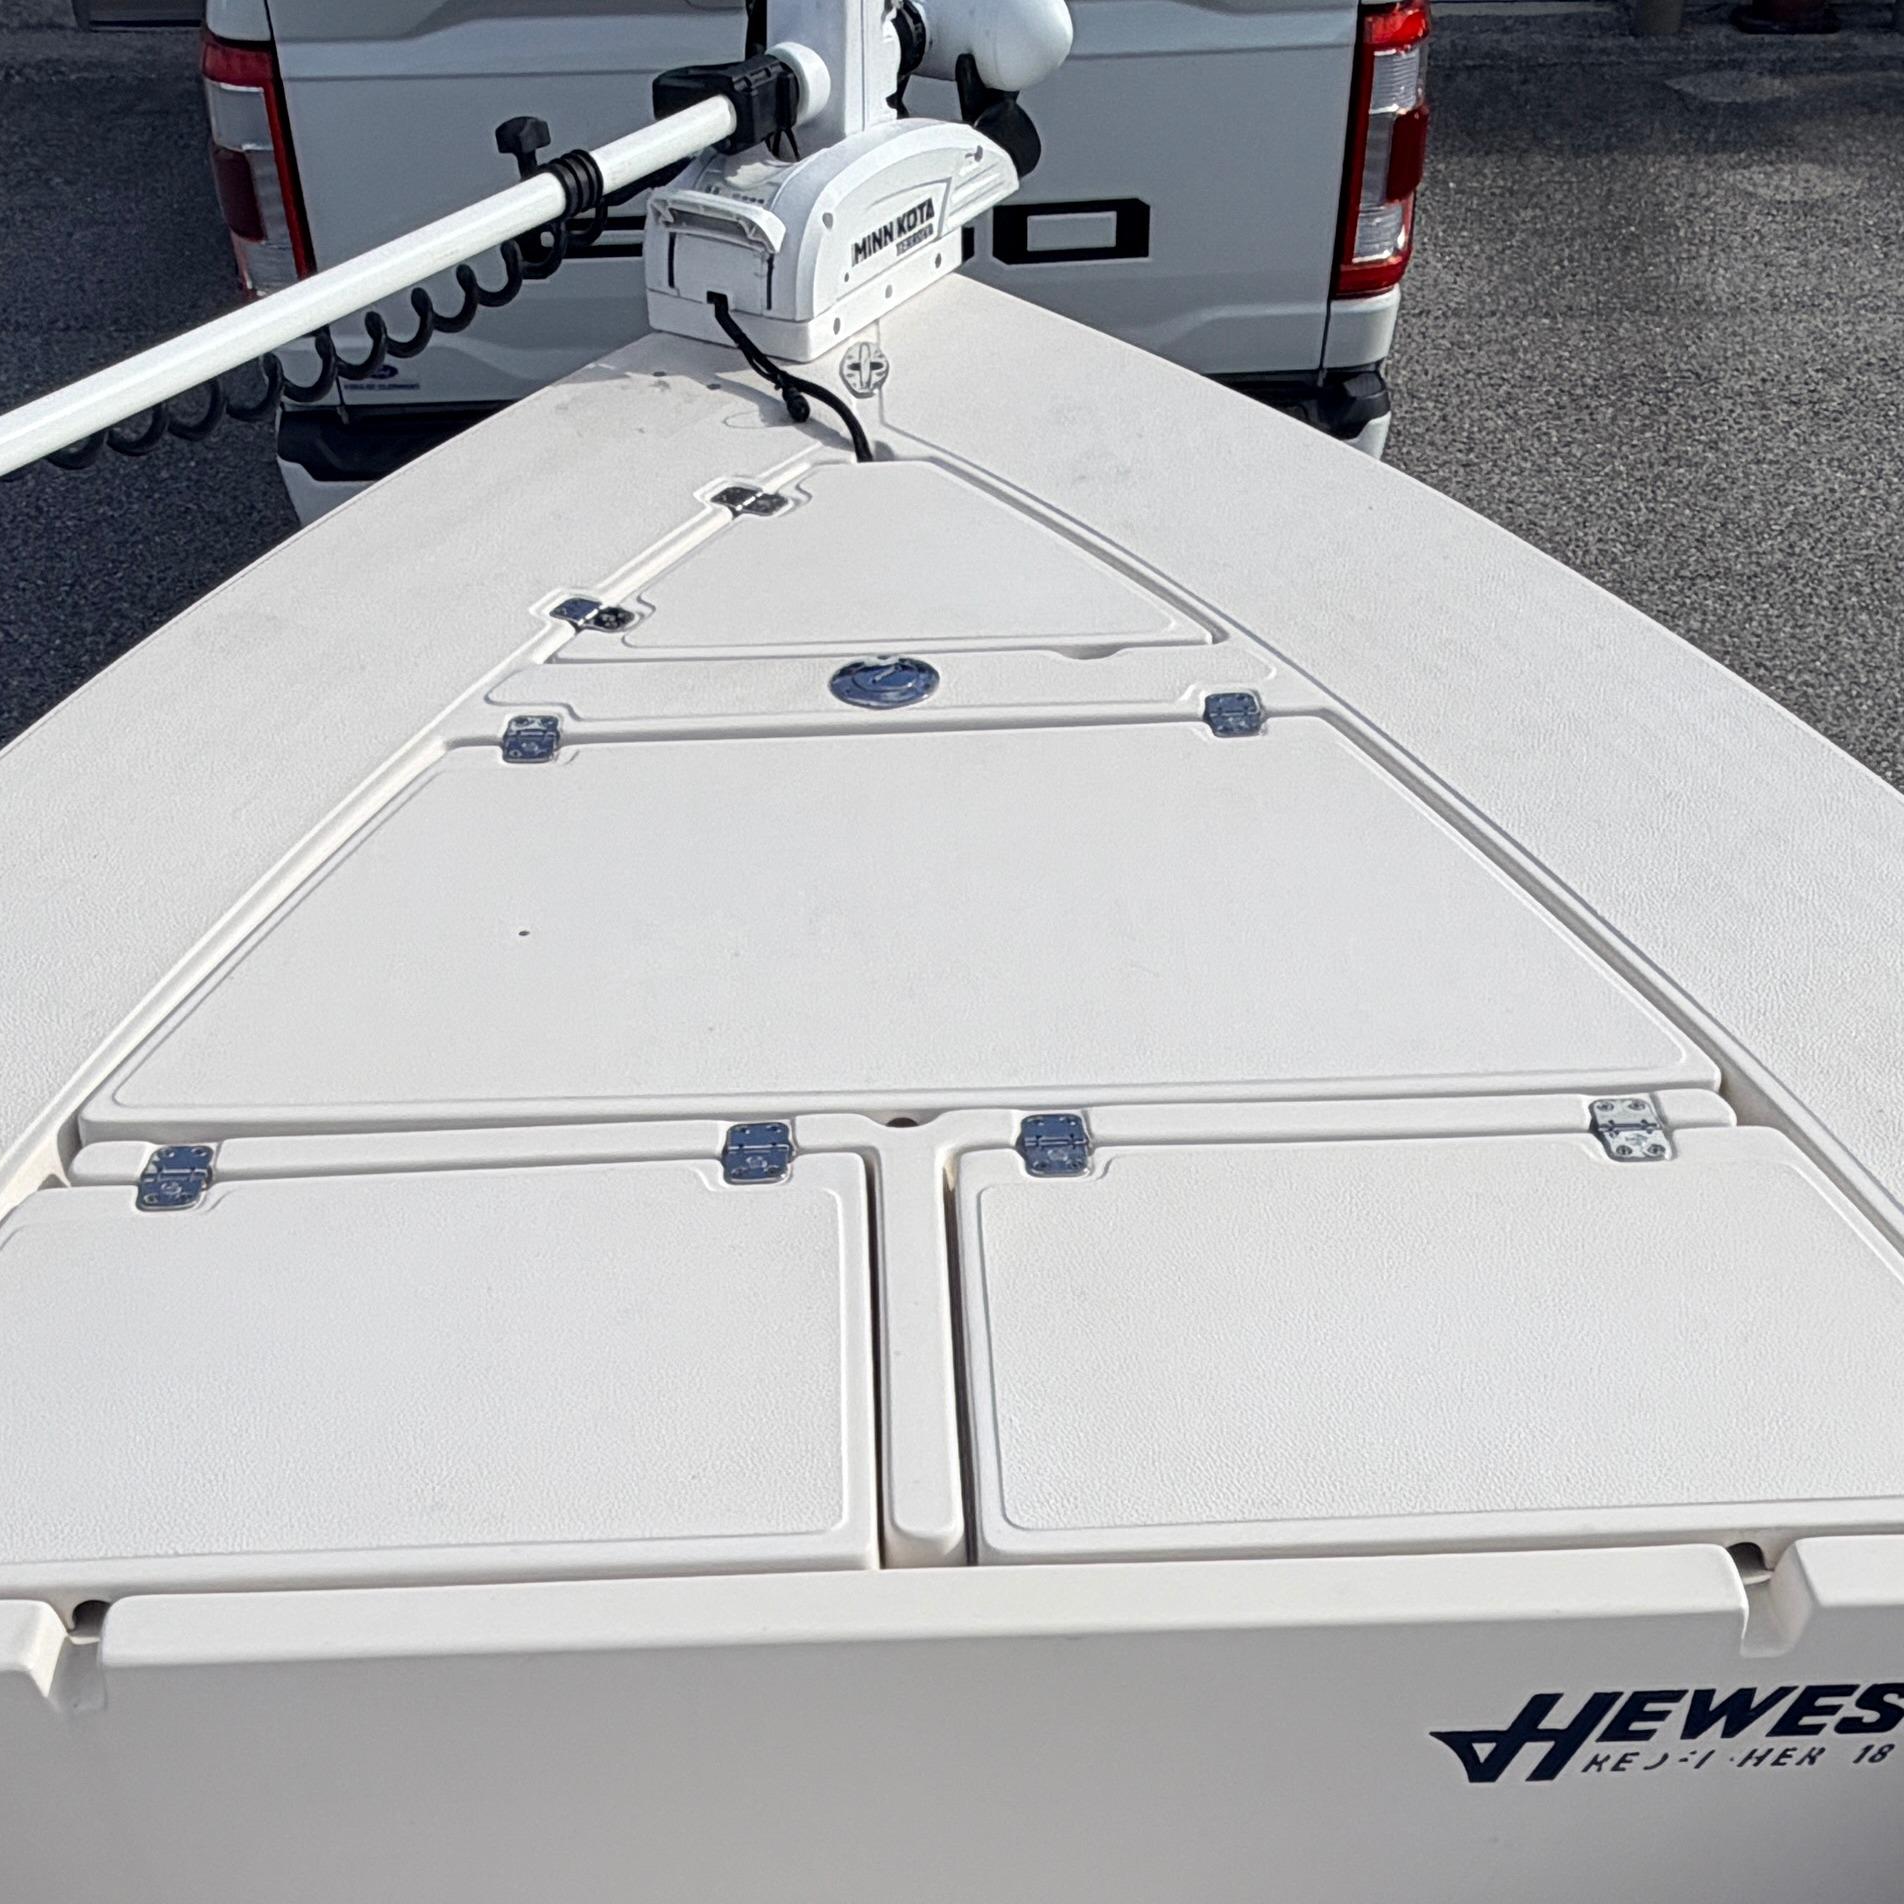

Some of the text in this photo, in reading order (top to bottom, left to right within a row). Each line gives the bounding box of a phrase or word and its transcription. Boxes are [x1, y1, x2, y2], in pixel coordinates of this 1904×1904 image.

[851, 221, 895, 268] MINN
[895, 197, 935, 239] KOTA
[1852, 1743, 1896, 1765] 18
